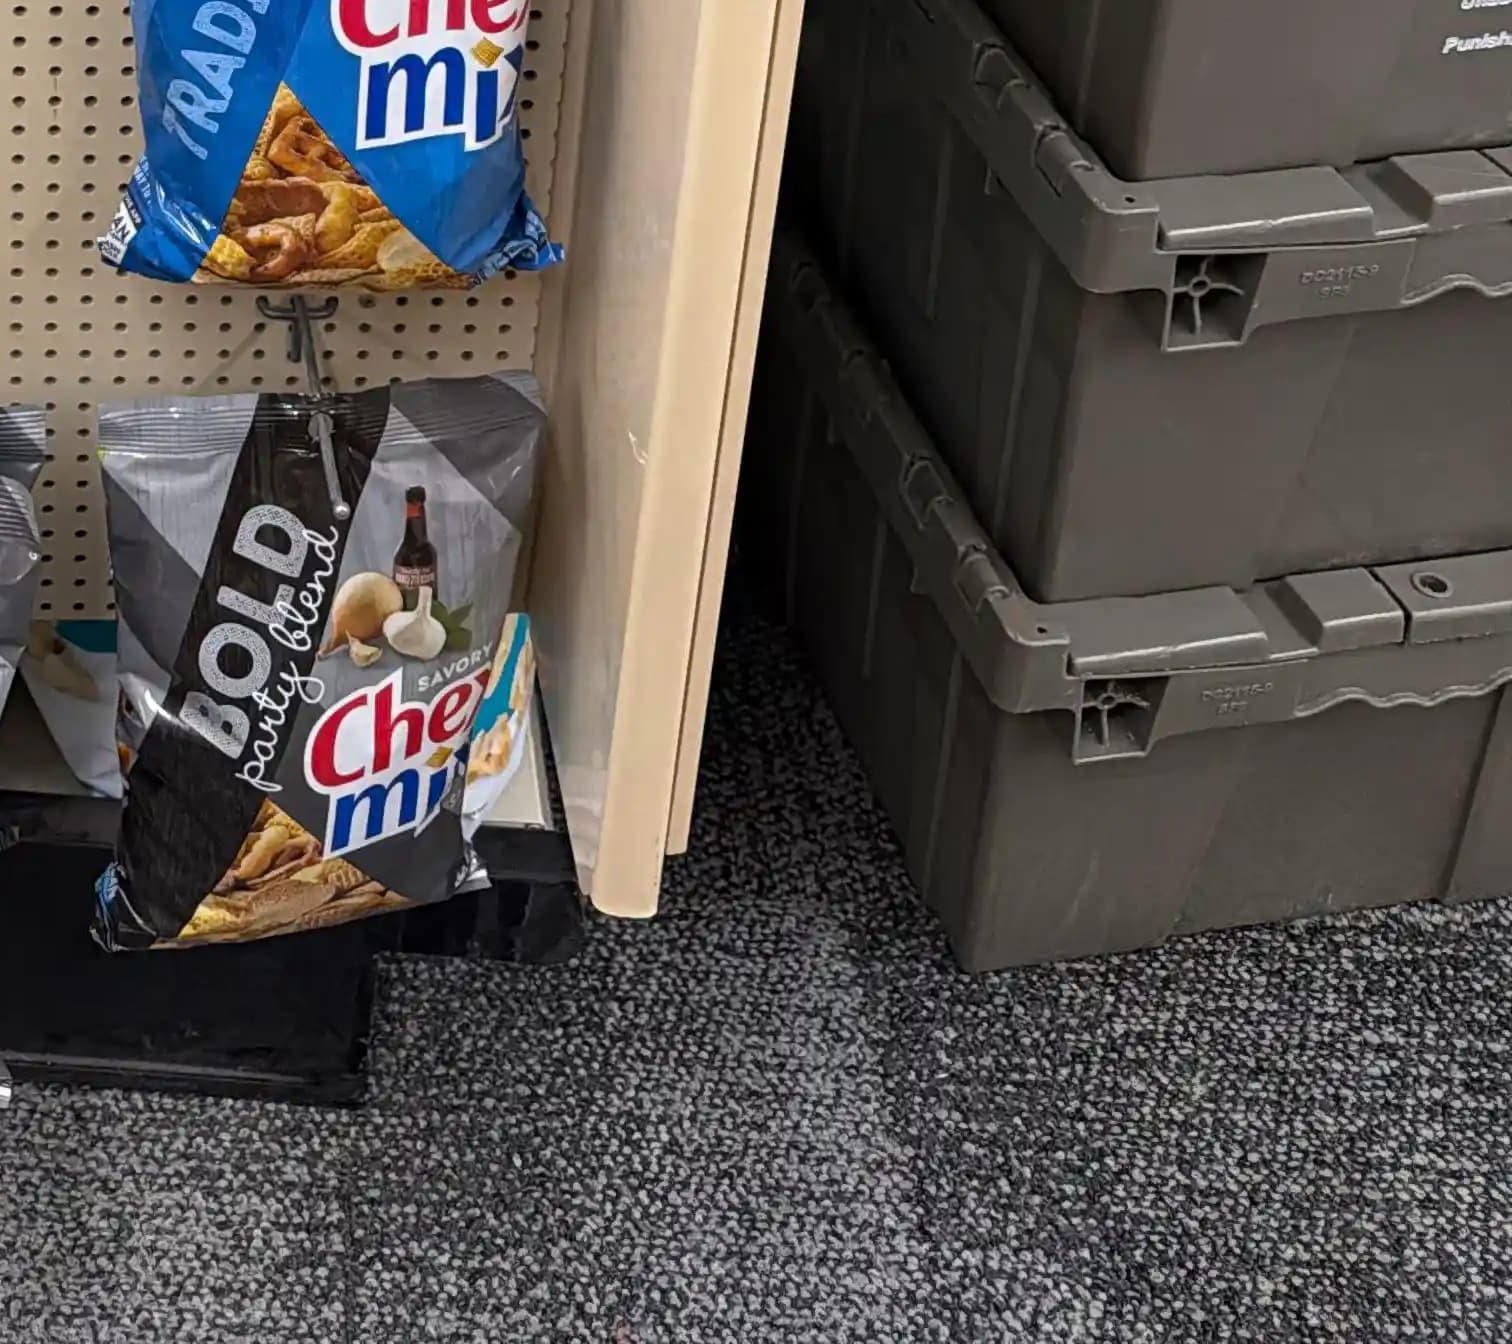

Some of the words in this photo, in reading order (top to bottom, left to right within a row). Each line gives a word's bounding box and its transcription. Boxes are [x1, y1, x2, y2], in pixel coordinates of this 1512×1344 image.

[181, 504, 309, 759] BOLD
[269, 525, 339, 652] blend
[235, 660, 325, 793] party
[418, 642, 493, 692] SAVORY
